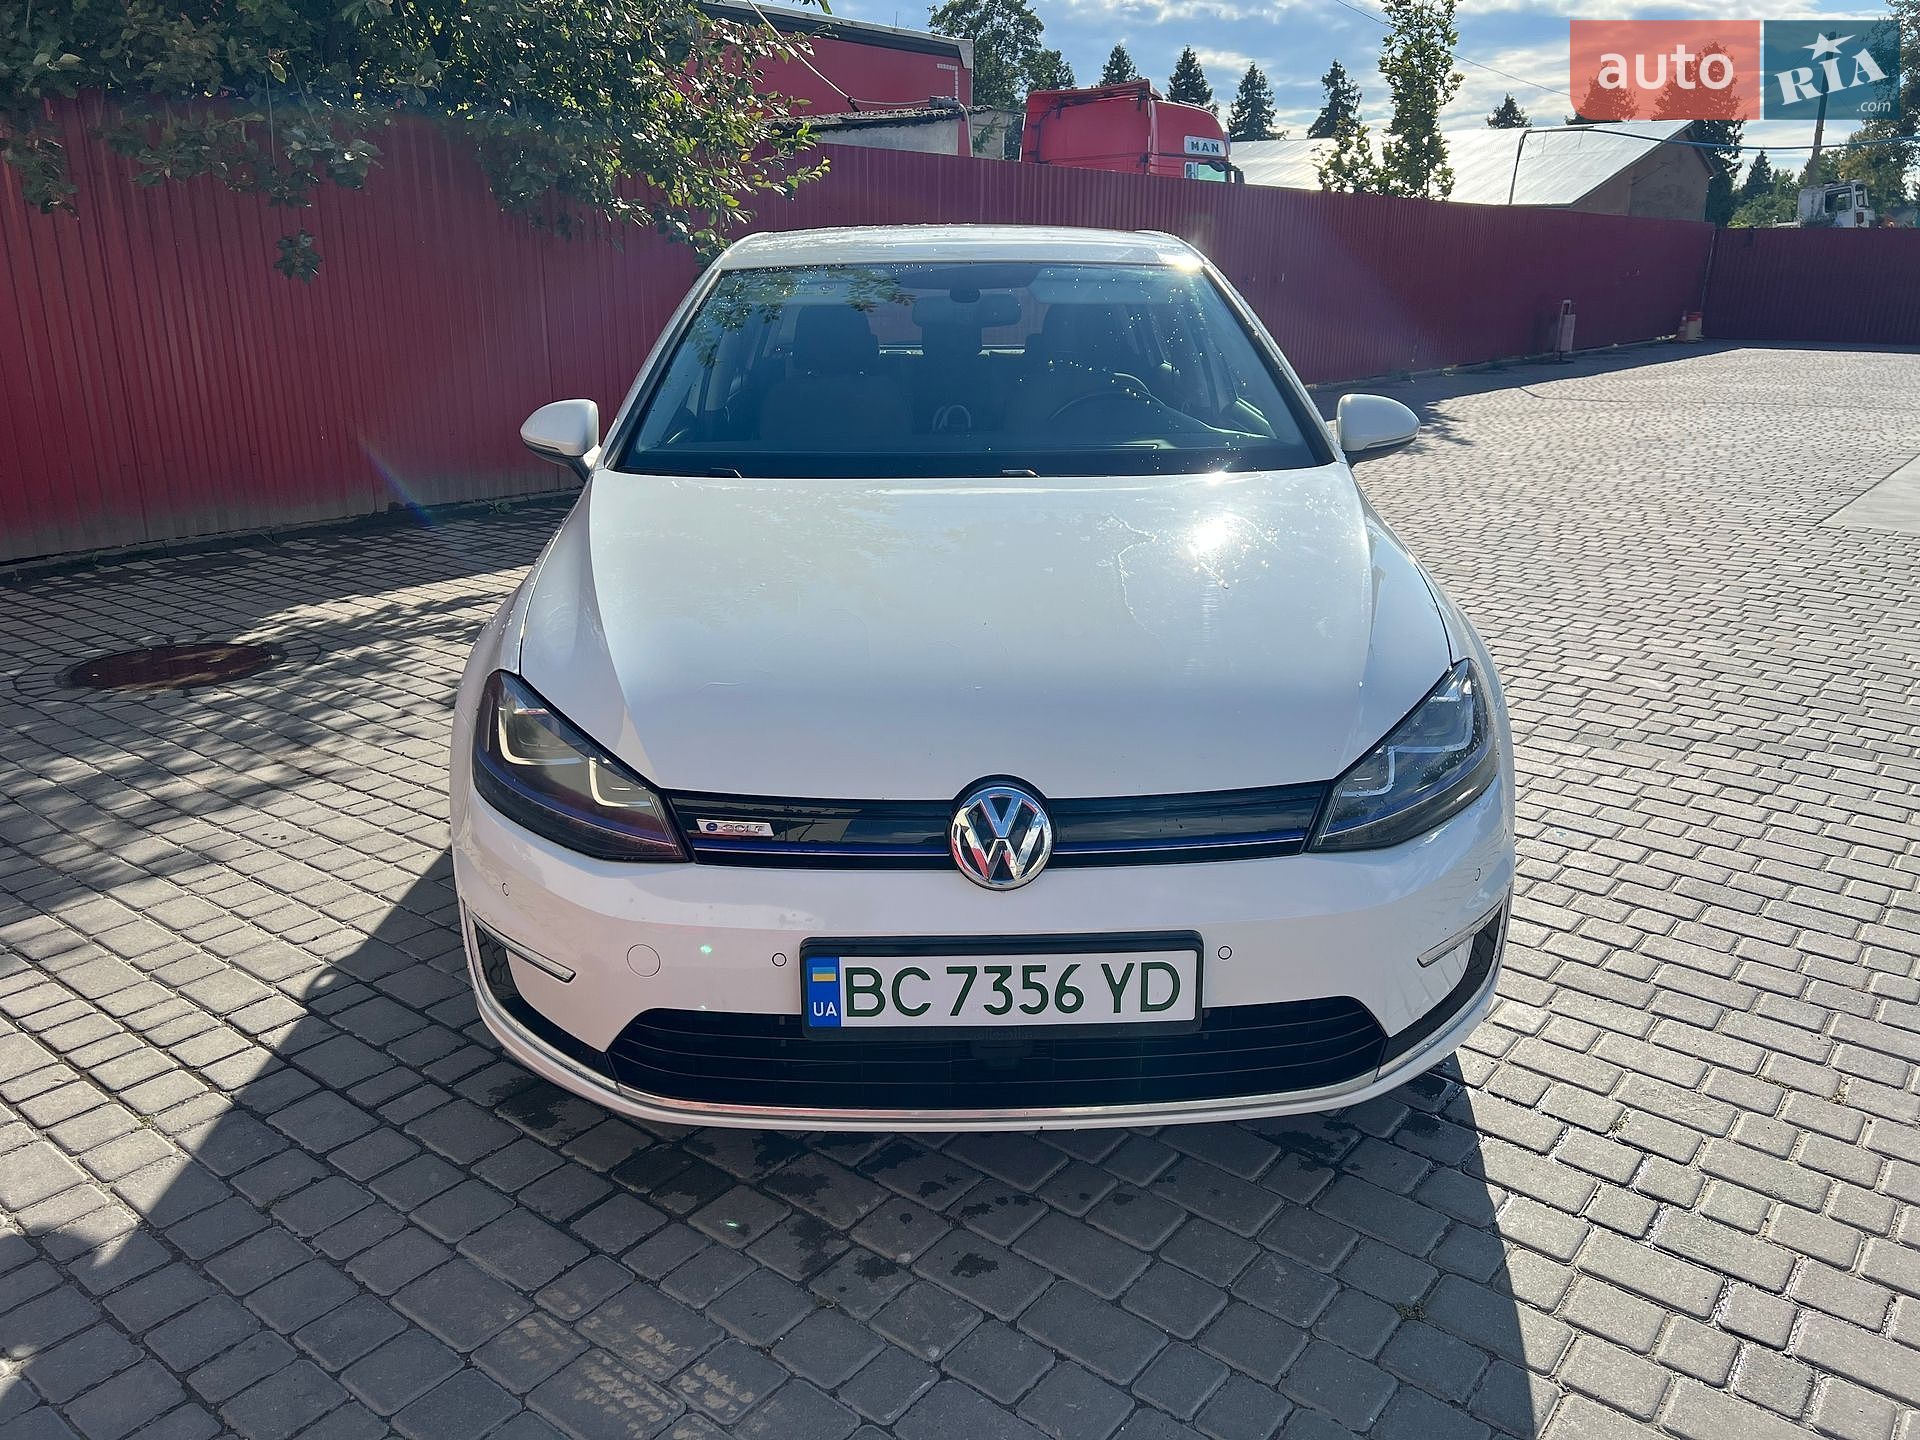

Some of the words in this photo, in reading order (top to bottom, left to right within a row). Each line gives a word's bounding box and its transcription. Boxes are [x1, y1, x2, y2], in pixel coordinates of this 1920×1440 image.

[1191, 141, 1219, 153] MAN
[845, 966, 931, 1017] BC
[946, 964, 1085, 1016] 7356
[1101, 961, 1181, 1014] YD
[813, 1002, 837, 1017] UA
